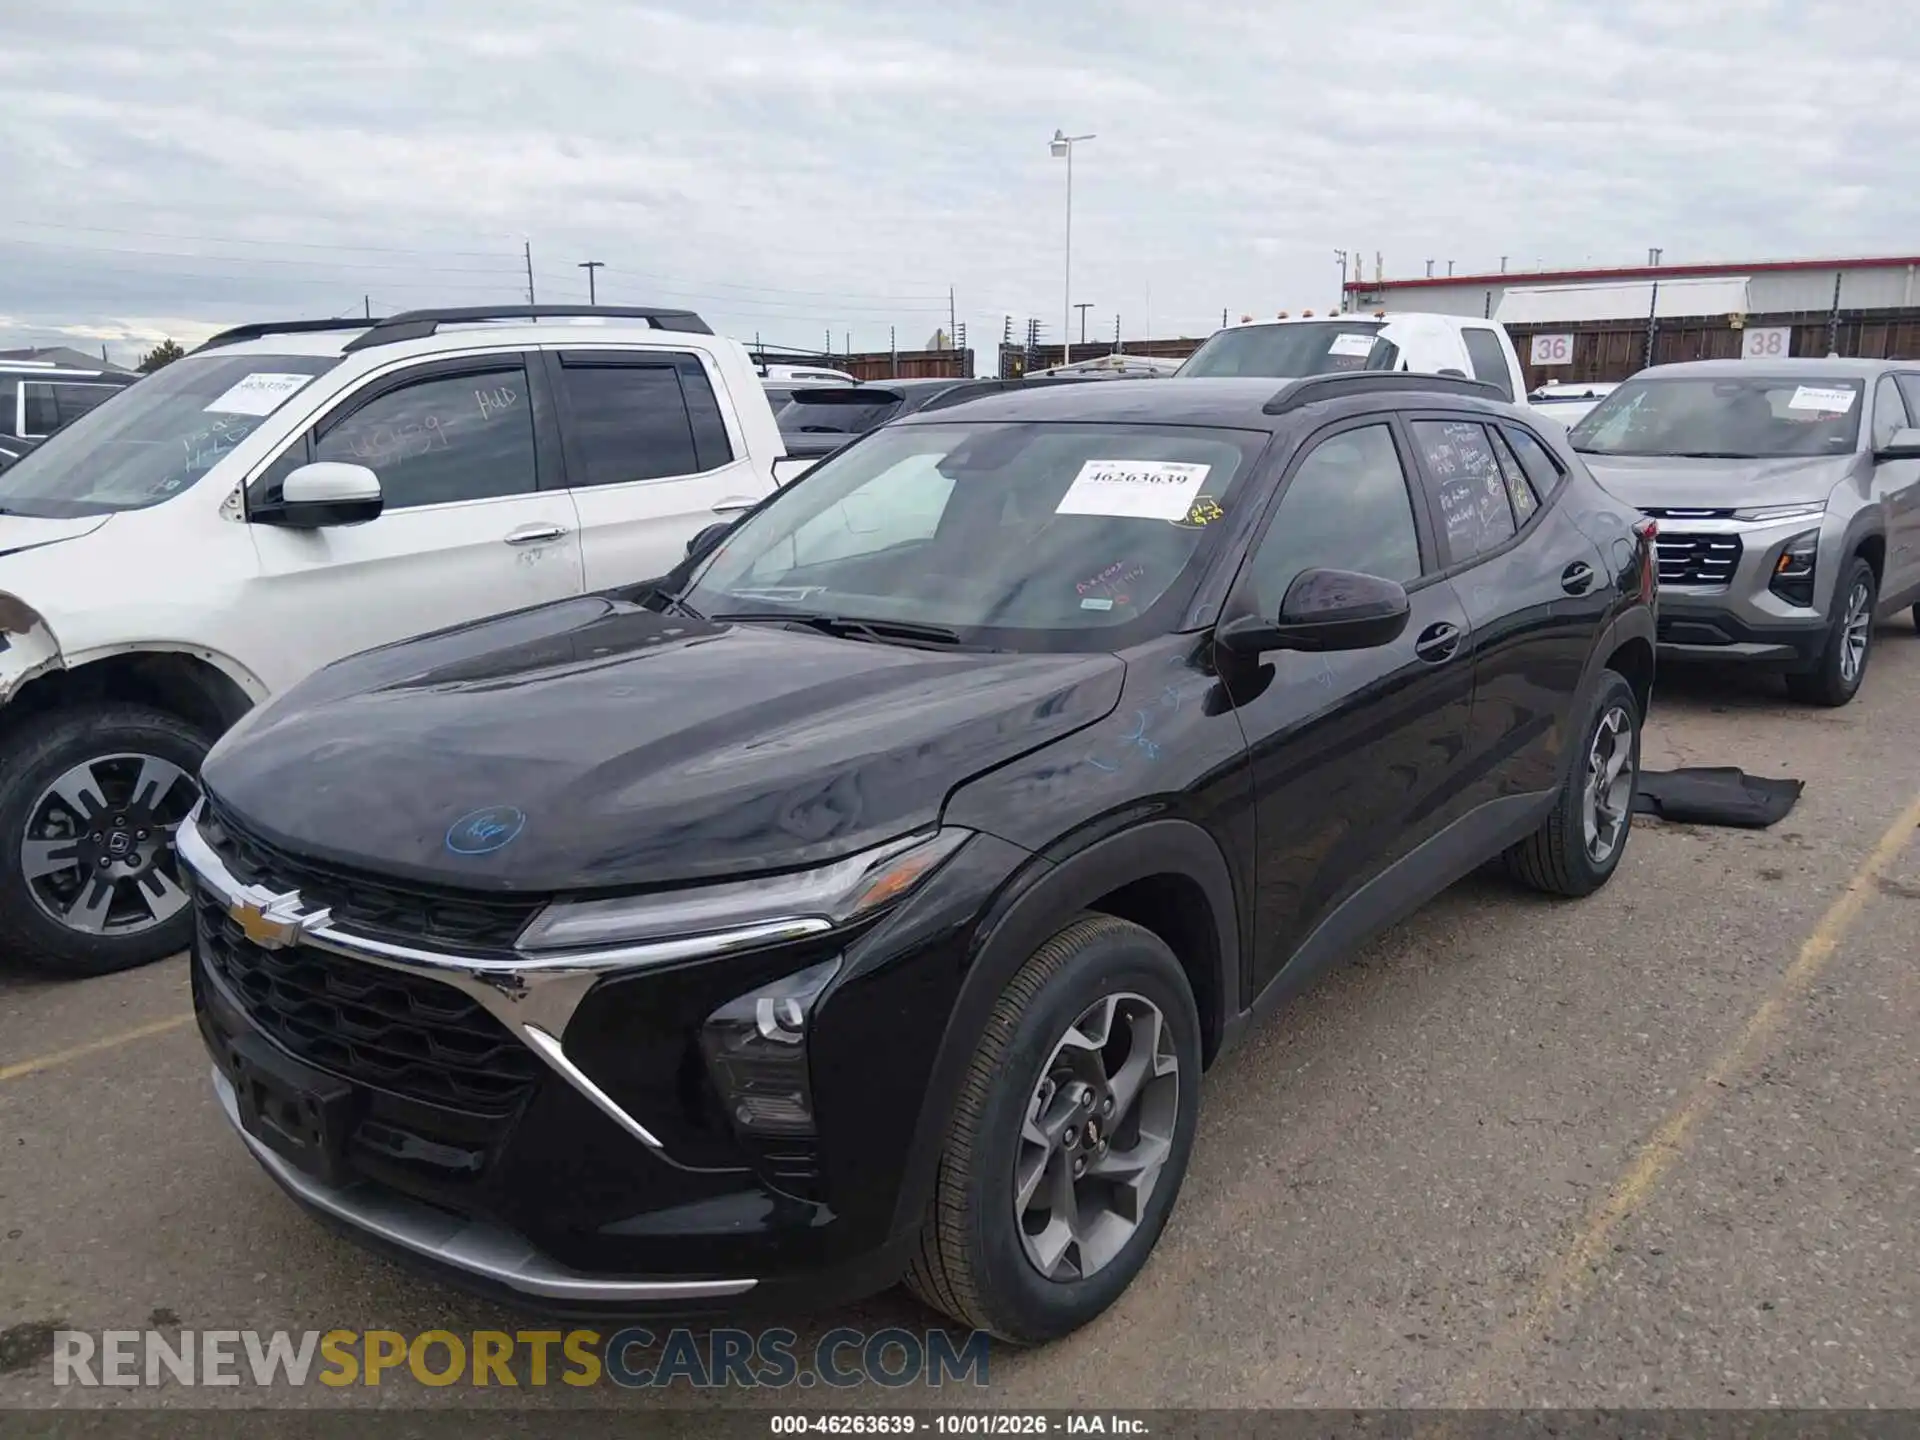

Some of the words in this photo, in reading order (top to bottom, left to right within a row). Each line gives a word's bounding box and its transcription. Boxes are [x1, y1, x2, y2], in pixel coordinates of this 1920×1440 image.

[1537, 338, 1566, 360] 36
[1750, 332, 1782, 355] 38
[1089, 471, 1189, 485] 46263639
